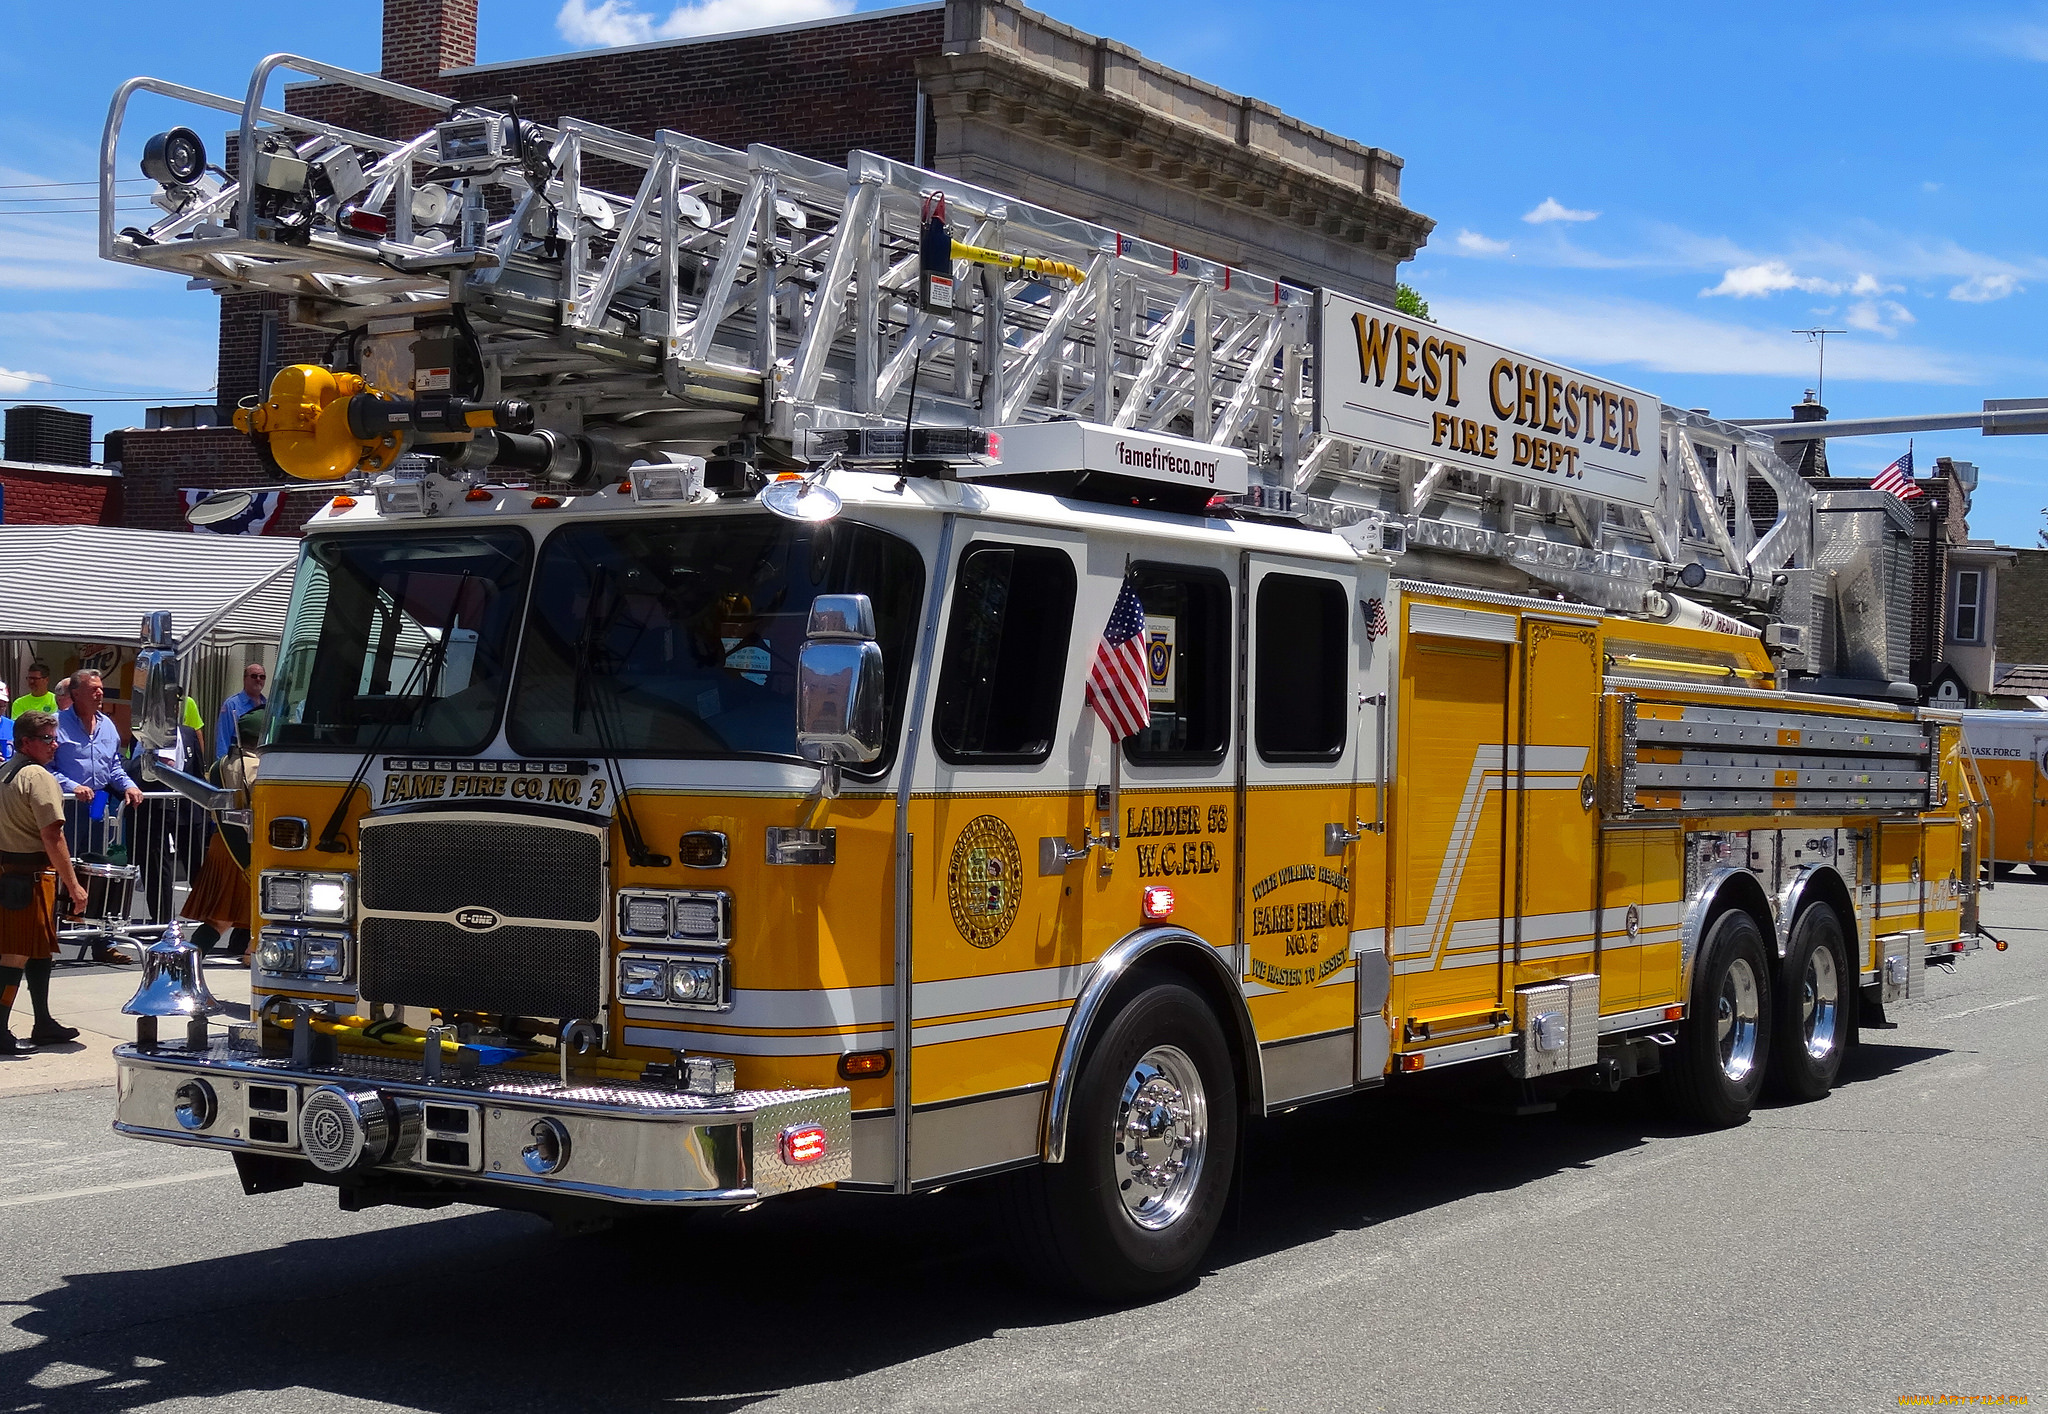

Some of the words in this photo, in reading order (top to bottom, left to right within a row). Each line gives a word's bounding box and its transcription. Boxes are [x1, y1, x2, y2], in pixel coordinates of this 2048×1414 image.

[1351, 311, 1467, 408] WEST
[1488, 357, 1640, 456] CHESTER
[1119, 441, 1215, 484] famefireco.org
[1431, 411, 1499, 459] FIRE
[1511, 432, 1584, 480] DEPT.
[1971, 747, 1991, 756] TASK
[1993, 748, 2021, 757] FORCE
[380, 774, 447, 806] FAME
[449, 775, 507, 798] FIRE
[511, 777, 544, 800] CO.
[543, 777, 582, 806] NO.
[587, 778, 608, 810] 3
[1126, 805, 1201, 838] LADDER
[1207, 804, 1228, 834] 53
[1136, 841, 1220, 878] W.C.F.D.
[1252, 872, 1279, 902] WITH
[1278, 863, 1317, 887] WILLING
[1318, 866, 1350, 893] HEARTS
[459, 913, 494, 925] E-ONE
[1252, 903, 1294, 936] FAME
[1297, 901, 1327, 931] FIRE
[1329, 899, 1349, 927] CO.
[1285, 933, 1309, 956] NO.
[1310, 932, 1319, 953] 3
[1252, 957, 1267, 979] WE
[1267, 963, 1302, 986] HASTEN
[1304, 965, 1315, 985] TO
[1318, 947, 1348, 980] ASSIST
